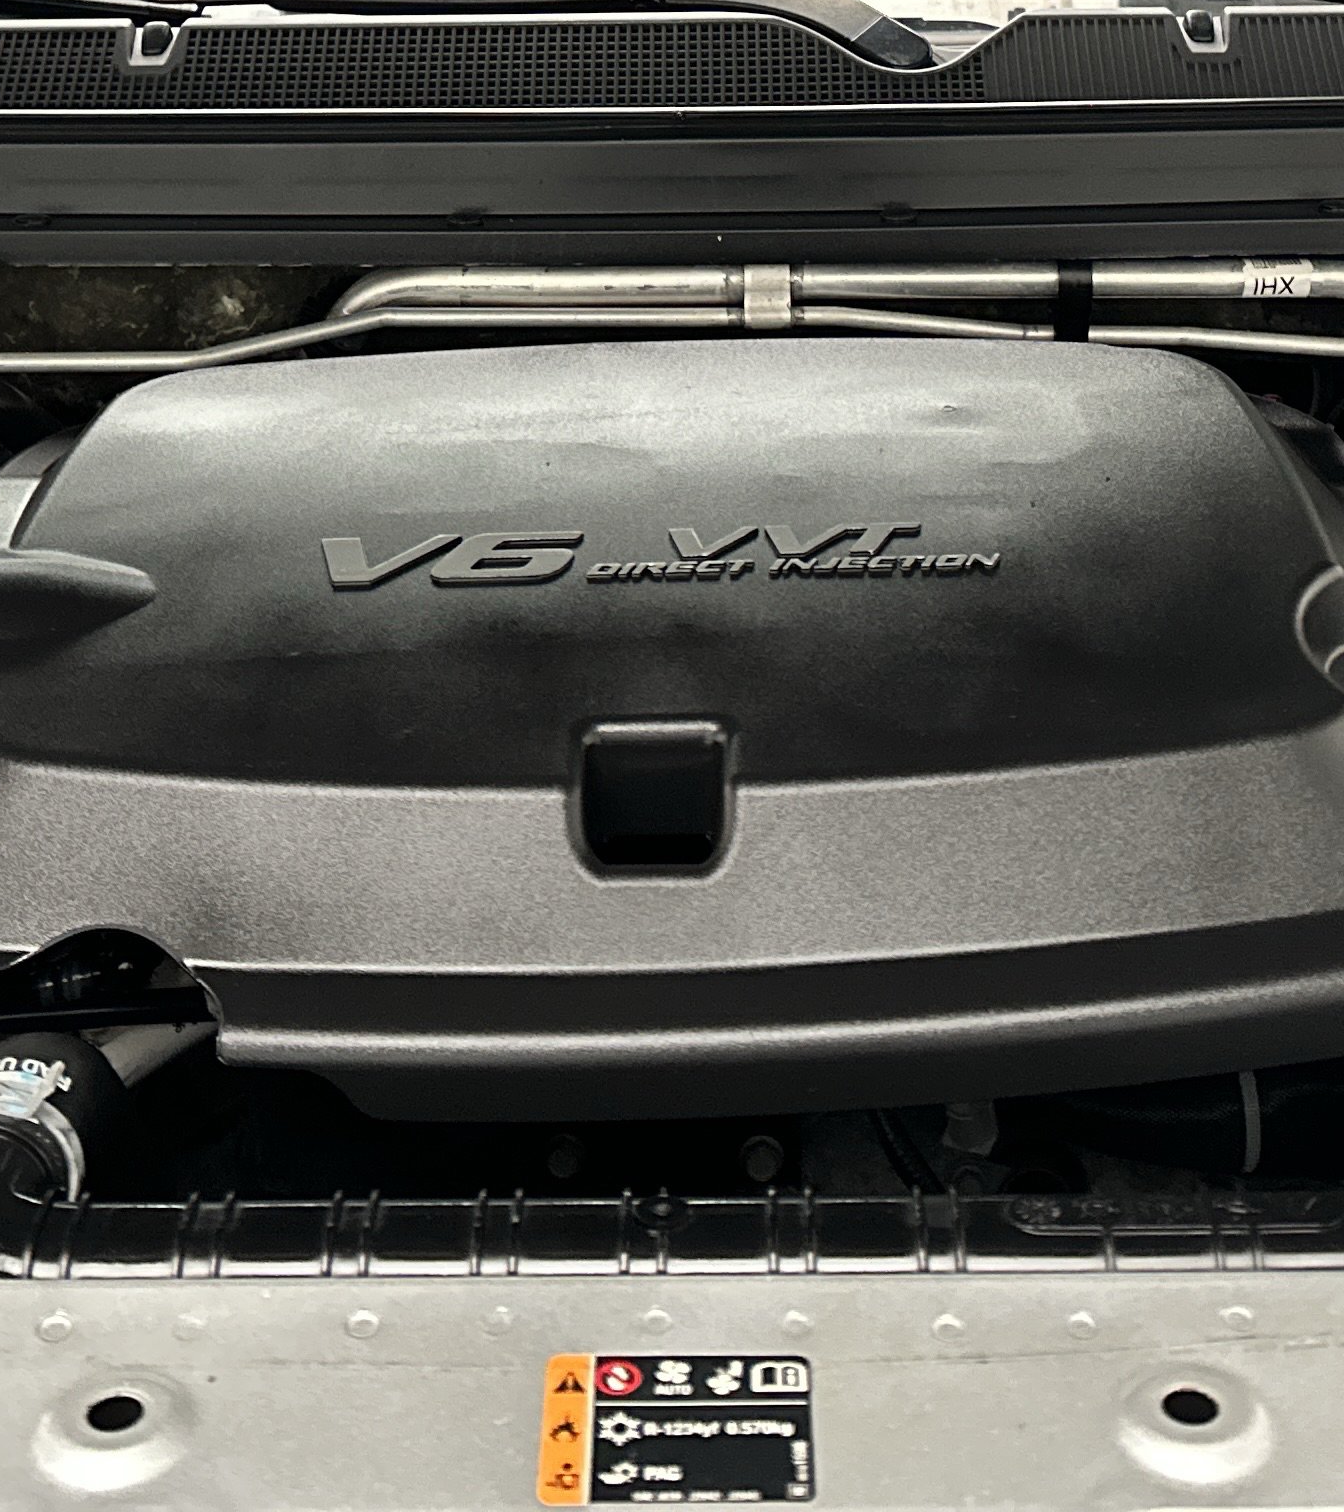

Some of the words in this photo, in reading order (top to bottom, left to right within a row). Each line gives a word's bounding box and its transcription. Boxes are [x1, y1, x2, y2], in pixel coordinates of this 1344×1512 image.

[321, 530, 585, 588] V6
[668, 521, 922, 561] VVT
[585, 558, 758, 581] DIRECT
[768, 552, 1002, 580] INJECTION
[654, 1383, 694, 1396] AUTO
